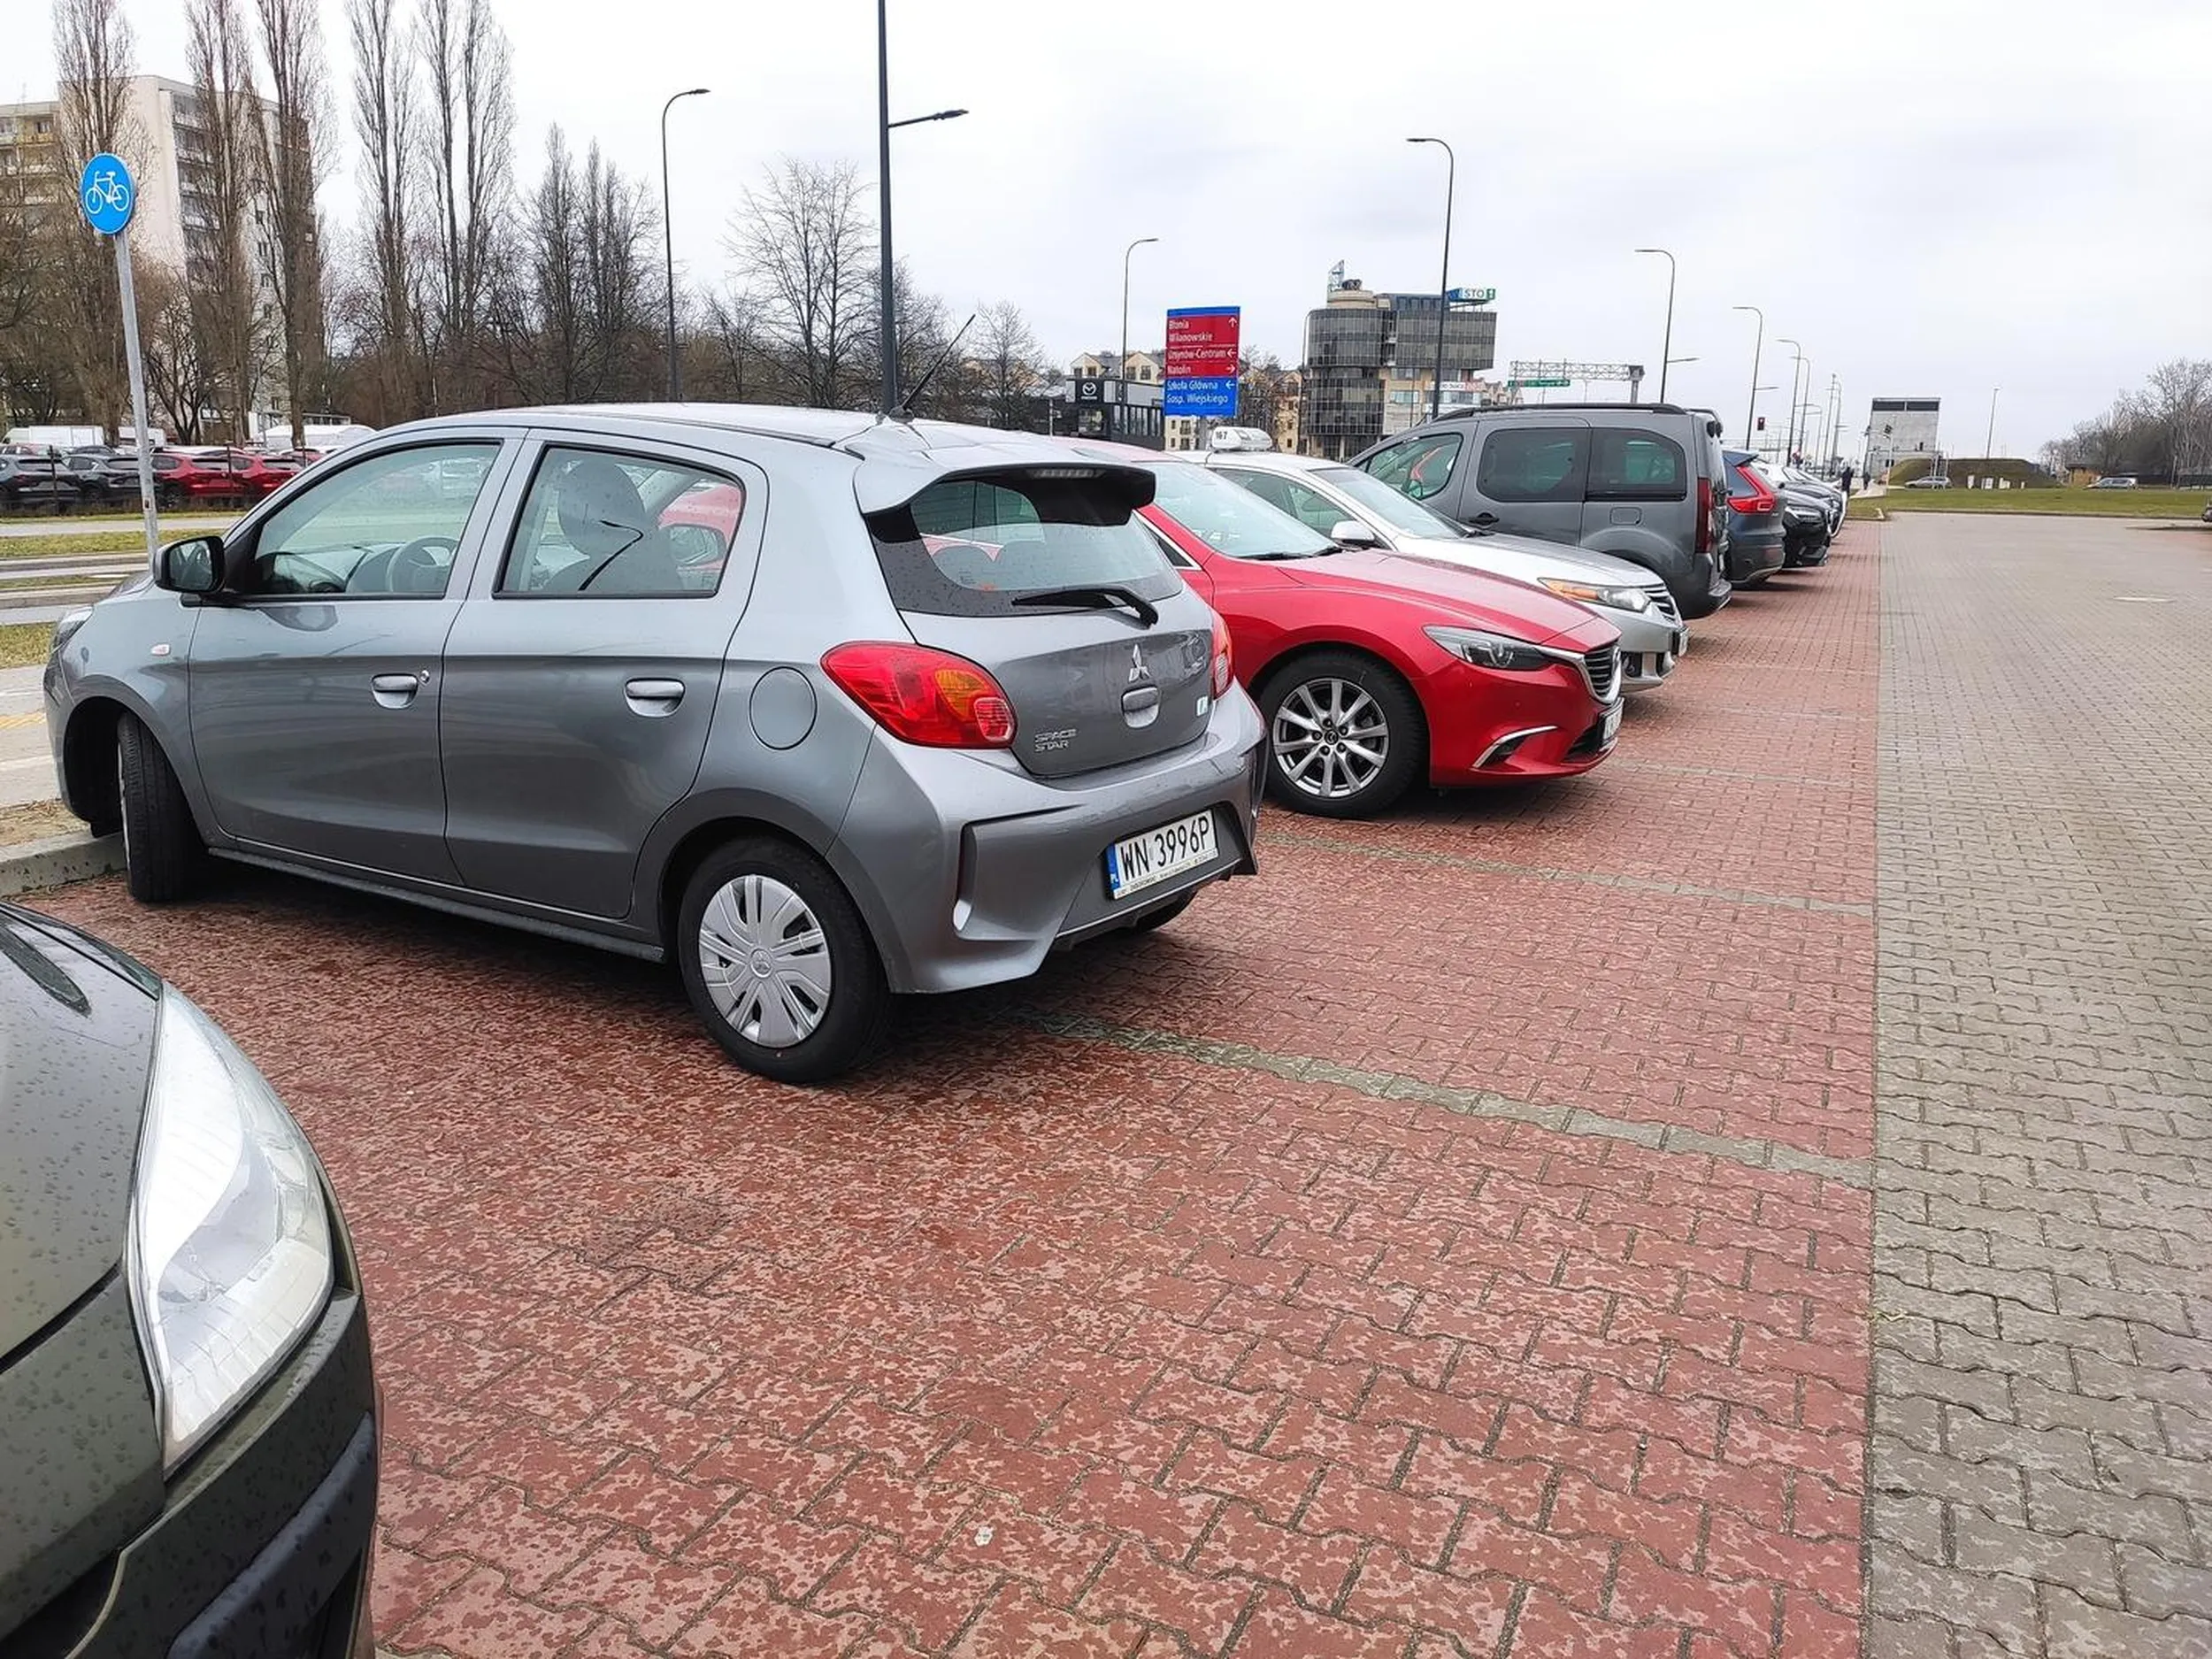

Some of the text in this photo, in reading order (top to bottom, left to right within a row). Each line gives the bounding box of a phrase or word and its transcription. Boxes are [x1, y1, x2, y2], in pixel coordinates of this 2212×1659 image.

[1034, 728, 1077, 742] SPACE
[1034, 740, 1069, 752] STAR
[1120, 815, 1210, 881] WN 3996P
